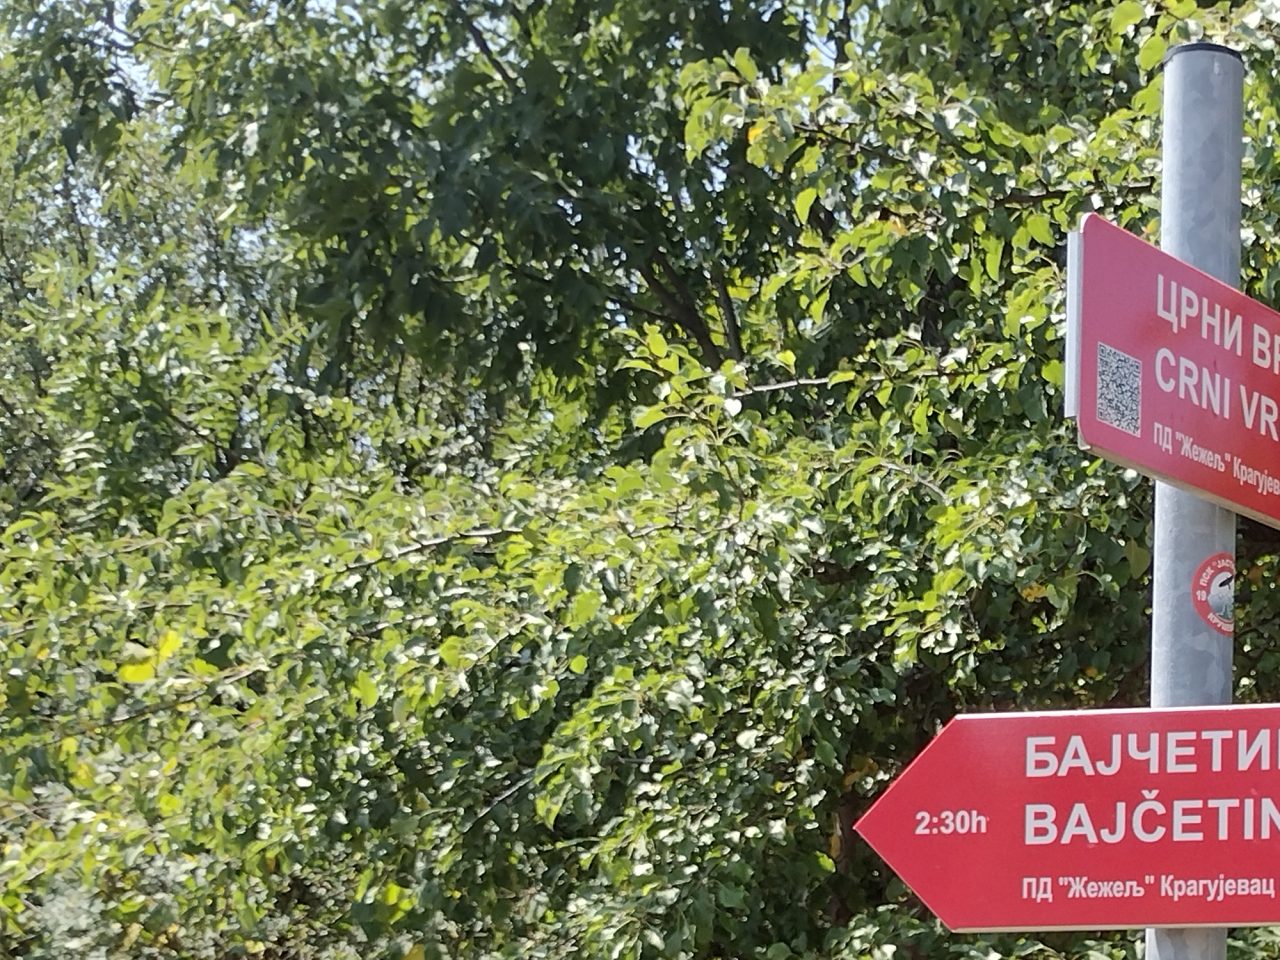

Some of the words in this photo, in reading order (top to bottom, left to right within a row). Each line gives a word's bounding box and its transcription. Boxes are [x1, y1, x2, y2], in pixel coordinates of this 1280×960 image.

[1157, 274, 1243, 356] ЦРНИ
[1155, 347, 1230, 420] CRNI
[1153, 421, 1173, 452] ПД
[915, 810, 988, 836] 2:30h
[1022, 876, 1053, 903] ПД
[1160, 874, 1277, 902] Крагујевац
